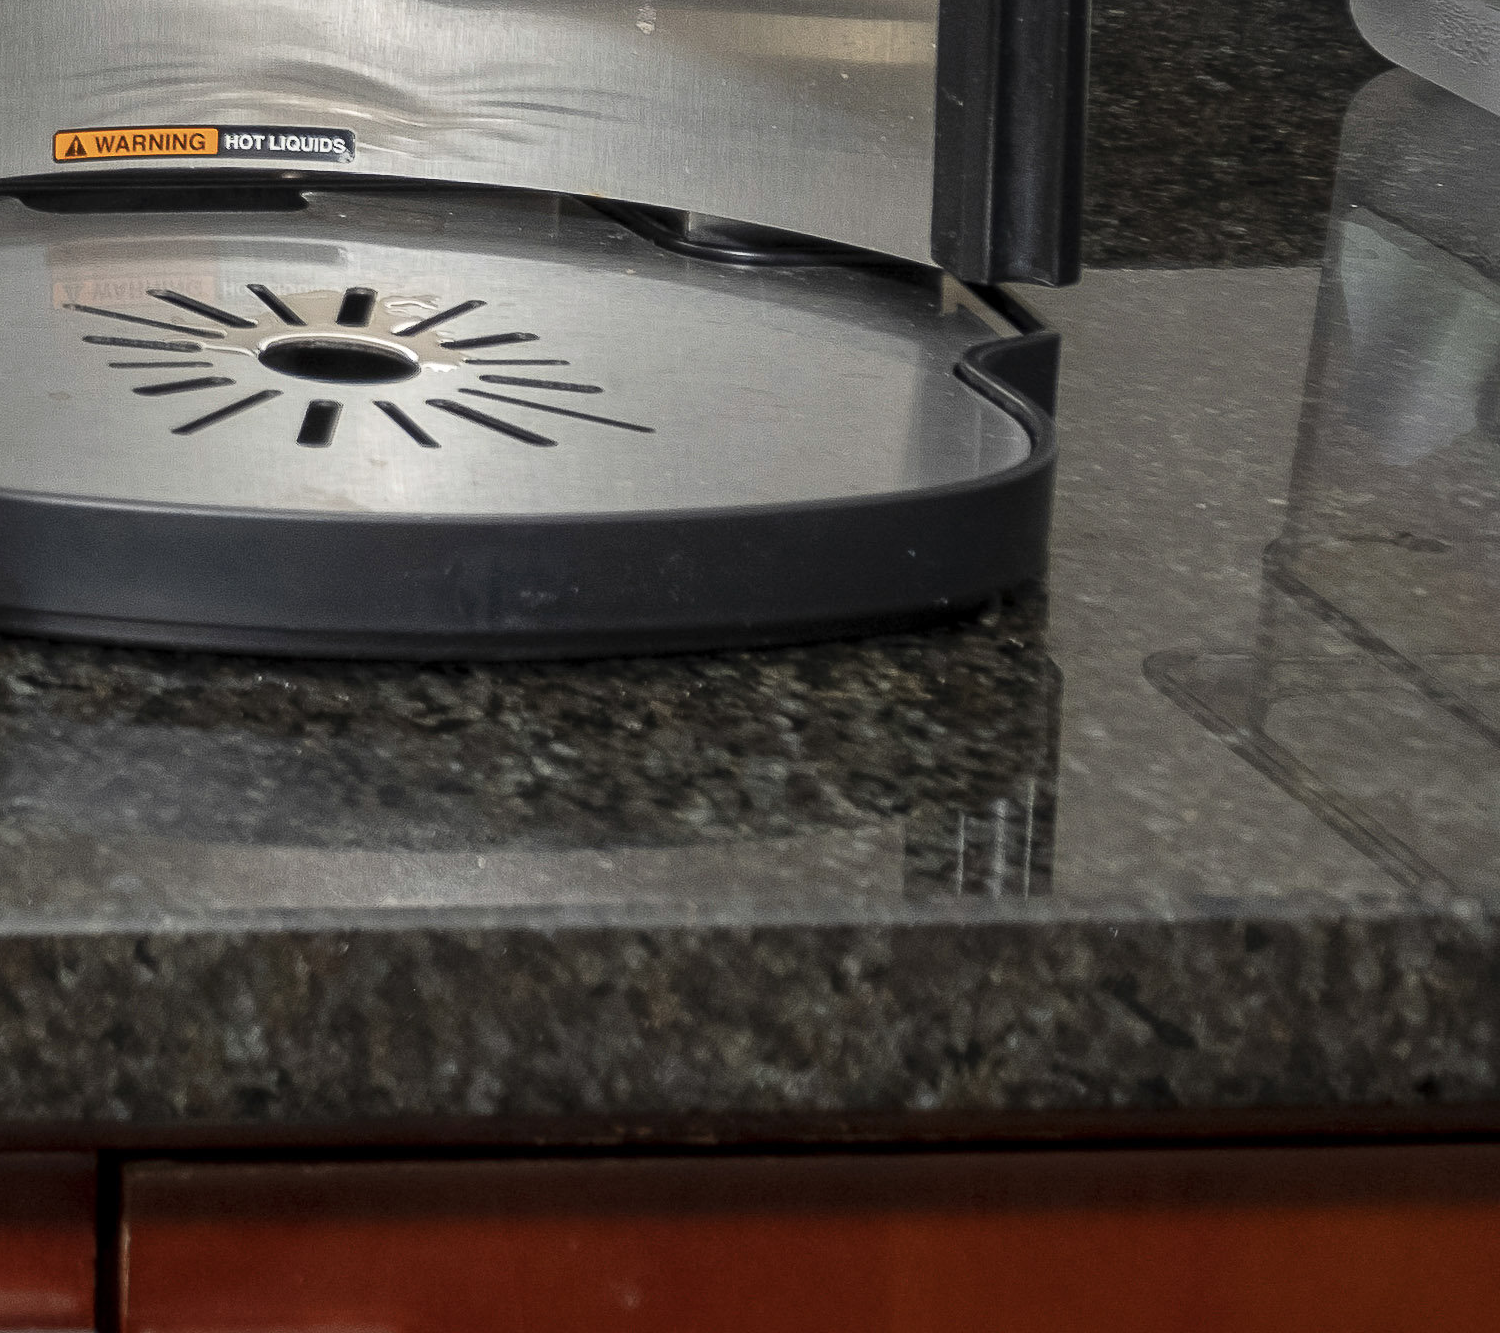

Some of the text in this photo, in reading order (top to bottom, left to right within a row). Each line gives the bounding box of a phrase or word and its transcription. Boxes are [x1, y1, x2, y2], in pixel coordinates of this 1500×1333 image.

[95, 132, 349, 155] WARNING HOT LIQUIDS
